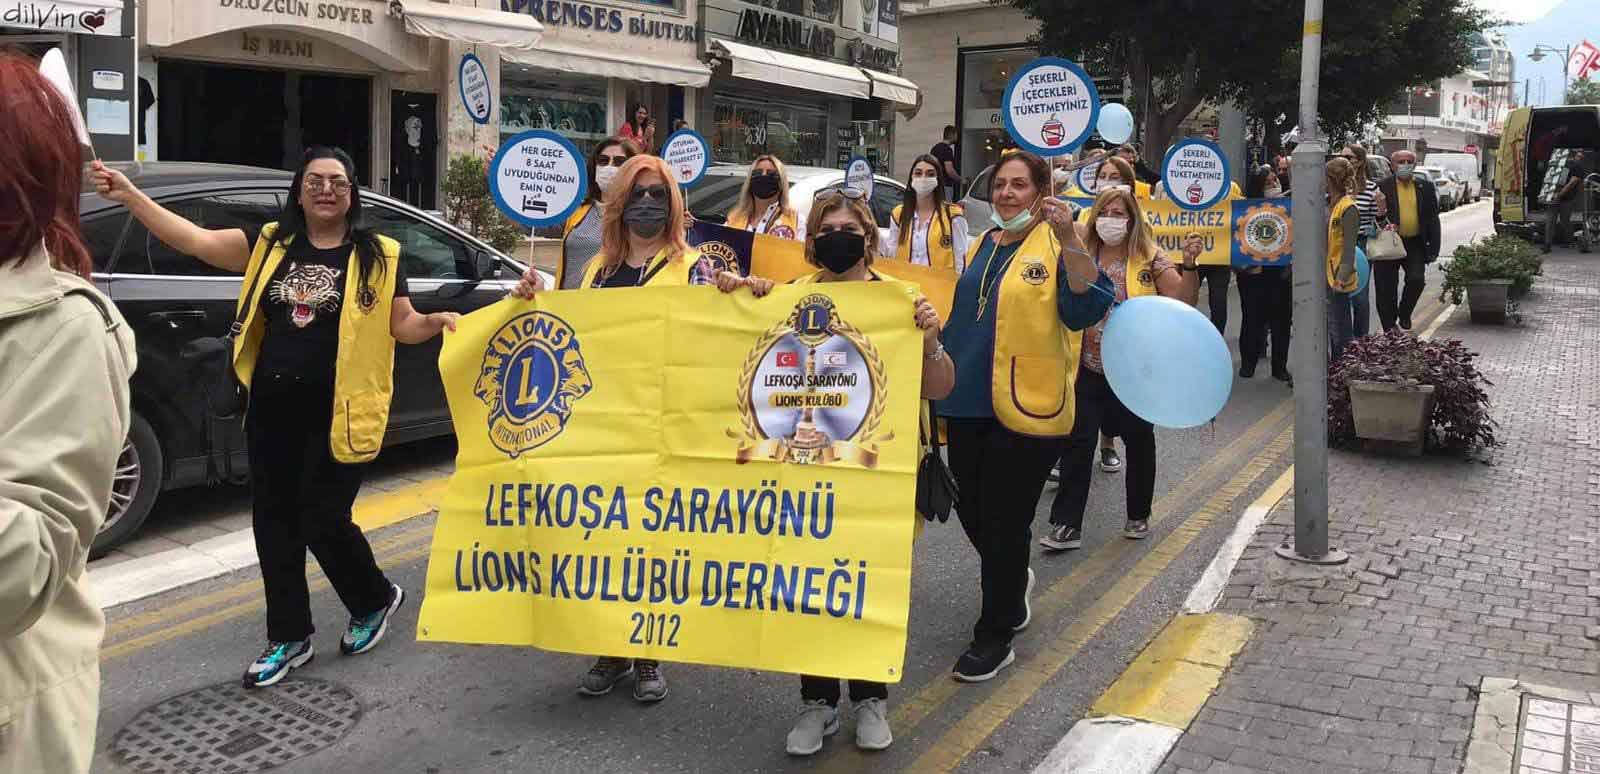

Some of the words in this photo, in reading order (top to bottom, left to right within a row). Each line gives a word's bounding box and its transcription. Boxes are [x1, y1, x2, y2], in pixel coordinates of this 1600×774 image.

[317, 4, 373, 24] SOYER
[521, 145, 539, 155] HER
[541, 147, 564, 158] GECE
[526, 158, 532, 167] 8
[534, 159, 556, 170] SAAT
[545, 185, 557, 194] OL
[1167, 211, 1225, 227] MERKEZ
[700, 244, 733, 260] LIONS
[497, 317, 568, 349] LIONS
[515, 356, 539, 406] L
[764, 374, 804, 390] LEFKOŞA
[807, 373, 858, 388] SARAYÖNÜ
[775, 396, 803, 407] LIONS
[805, 393, 842, 407] KULÜBÜ
[486, 483, 629, 540] LEFKOŞA
[642, 479, 835, 540] SARAYÖNÜ
[455, 542, 542, 595] LİONS
[550, 547, 692, 605] KULÜBÜ
[700, 558, 867, 620] DERNEĞİ
[629, 612, 682, 647] 2012
